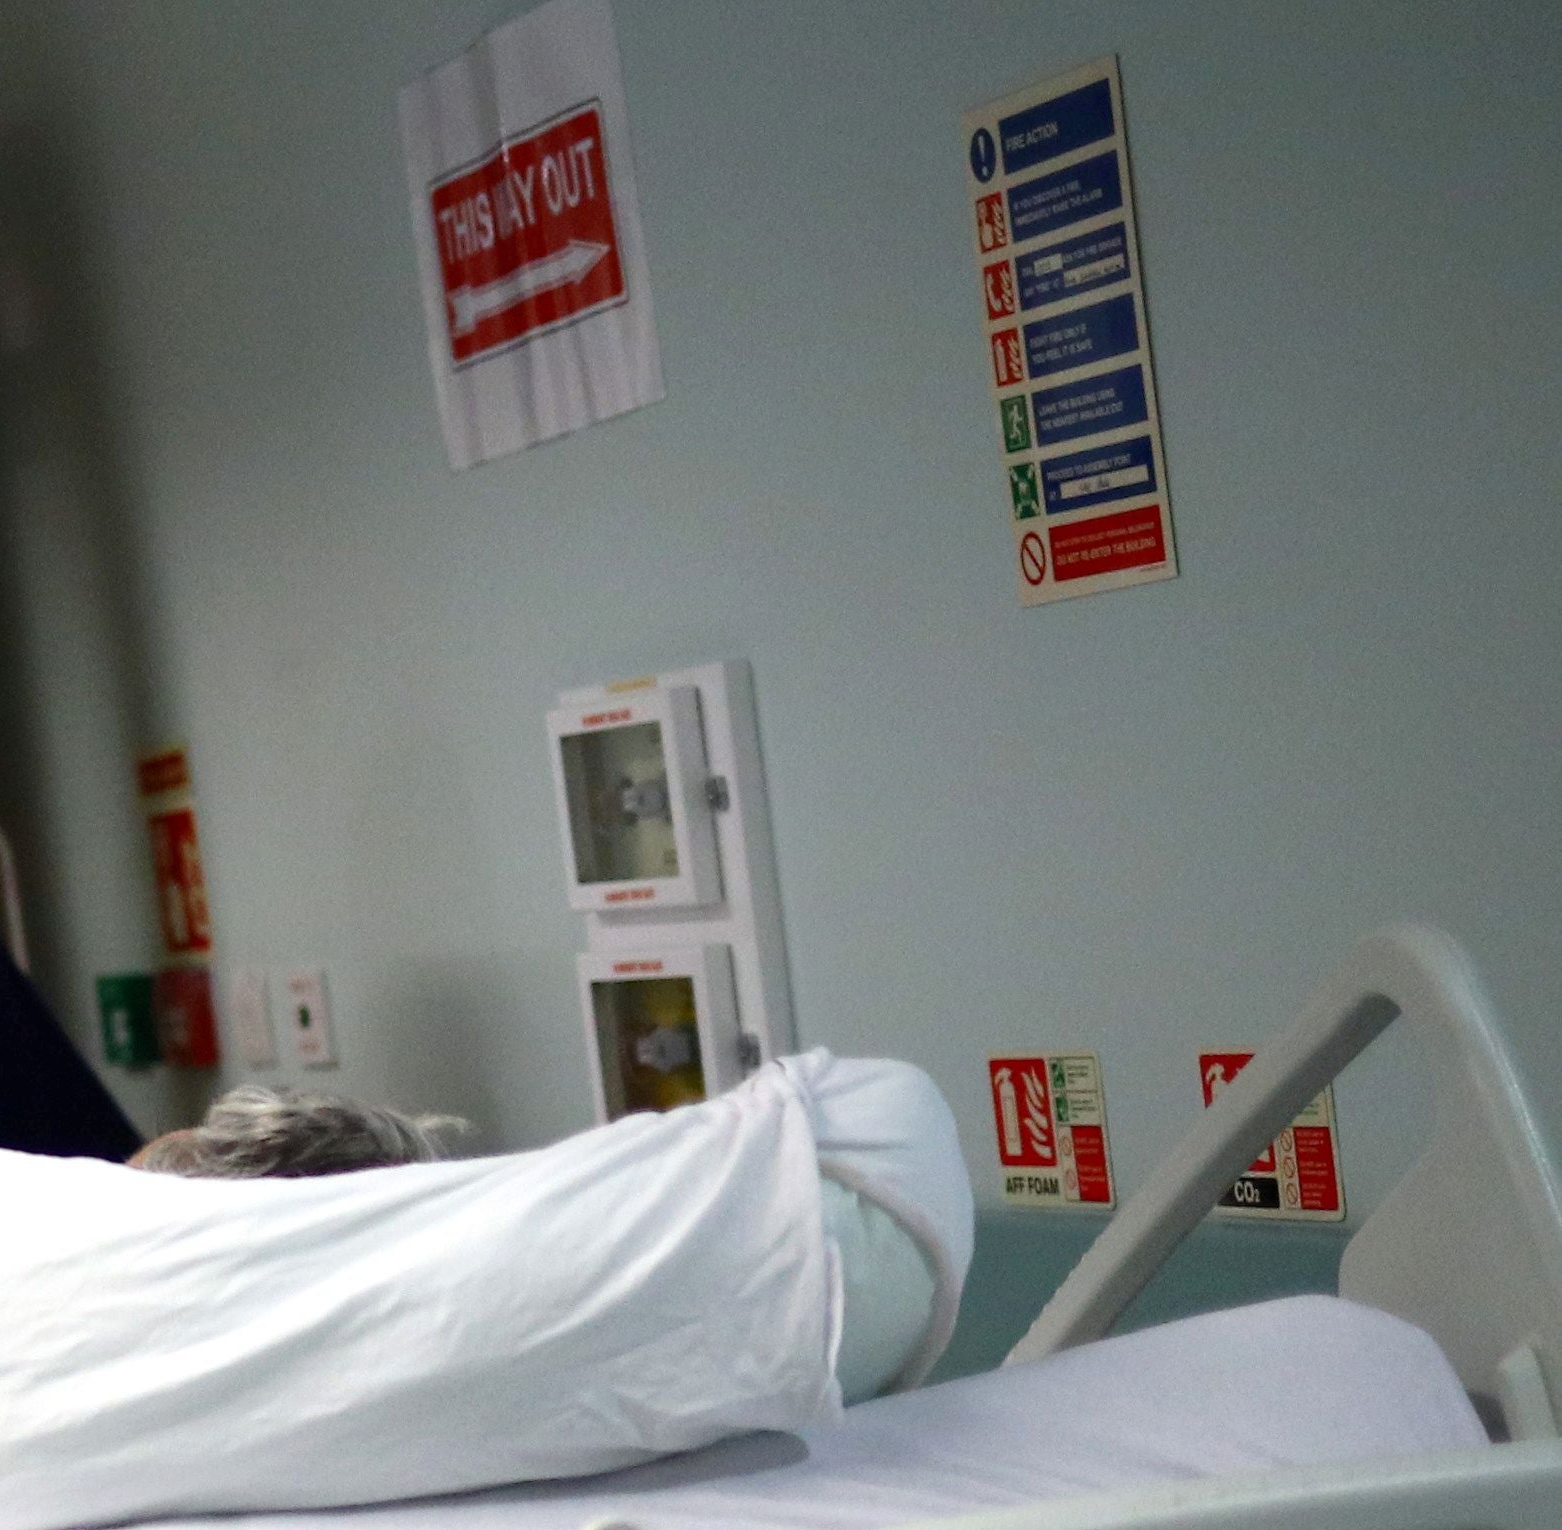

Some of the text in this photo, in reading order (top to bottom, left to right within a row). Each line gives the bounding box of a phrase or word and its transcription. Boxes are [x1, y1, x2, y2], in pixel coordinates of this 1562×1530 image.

[1026, 121, 1058, 144] ACTION
[439, 192, 495, 265] THIS
[541, 138, 596, 216] OUT
[1028, 1176, 1060, 1195] FOAM
